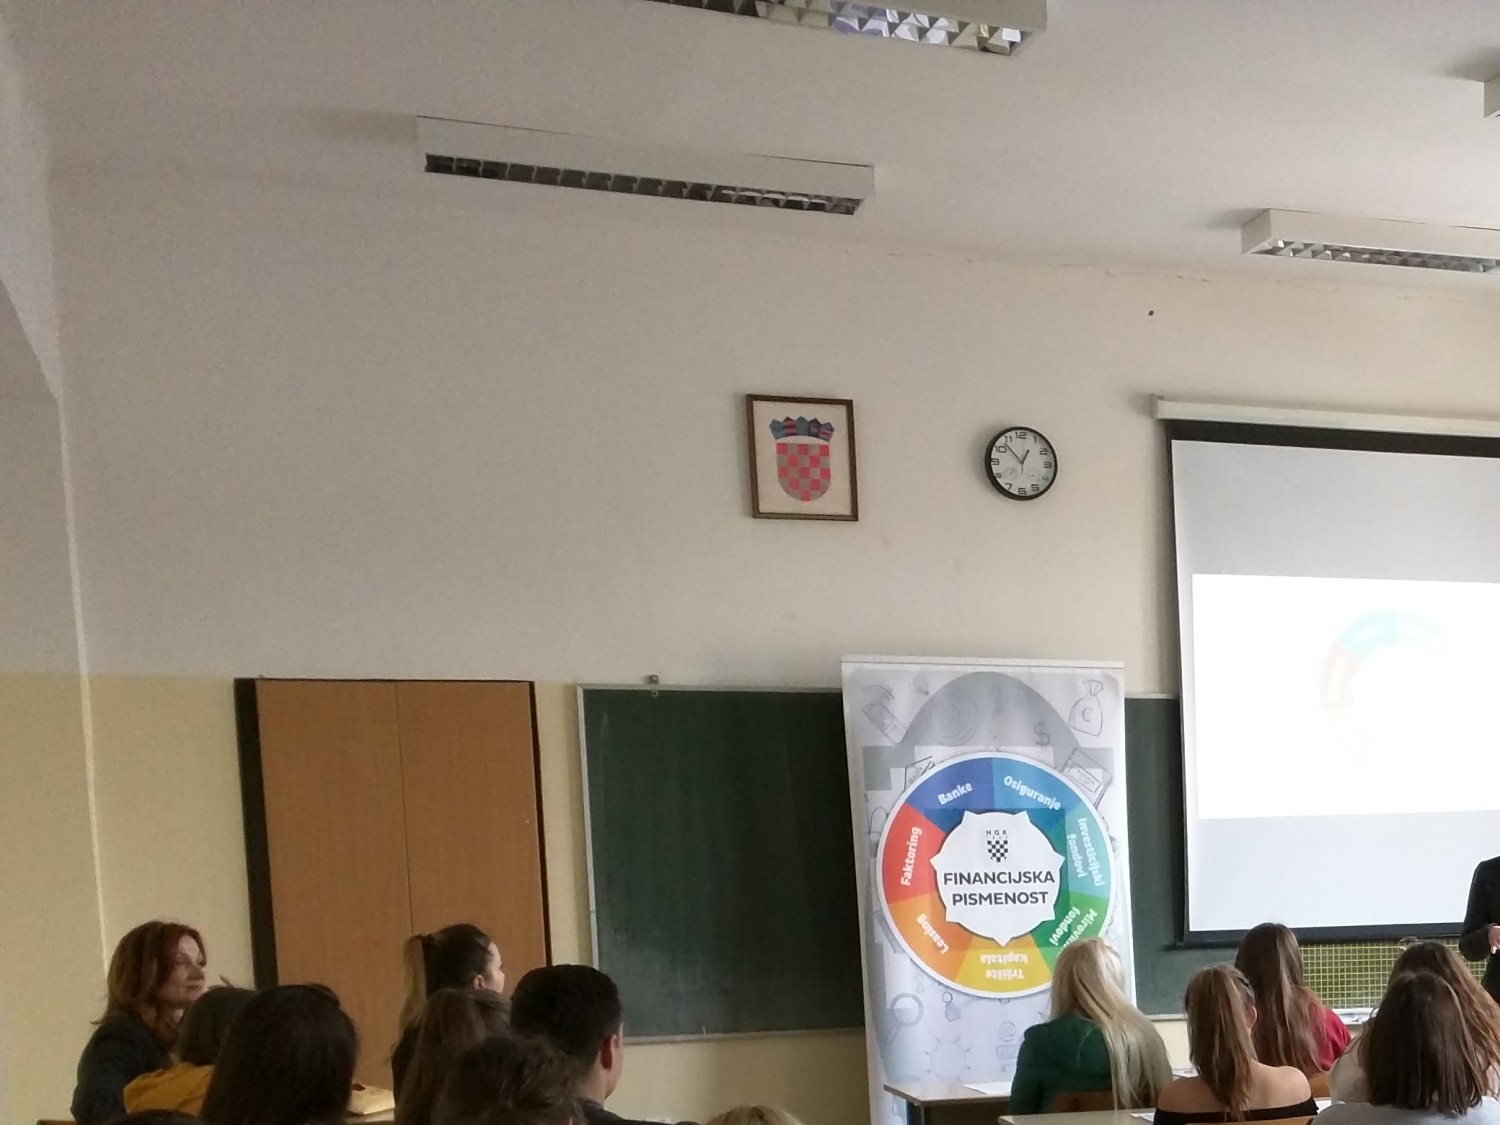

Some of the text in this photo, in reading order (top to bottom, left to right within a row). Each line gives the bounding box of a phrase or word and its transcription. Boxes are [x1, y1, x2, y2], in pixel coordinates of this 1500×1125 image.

[1004, 435, 1013, 443] 11
[994, 445, 1006, 453] 10
[1039, 447, 1048, 455] 2
[1004, 482, 1013, 490] 7
[1018, 487, 1027, 495] 6
[1030, 483, 1039, 492] 5
[937, 782, 973, 805] Banke
[1003, 775, 1062, 811] Osiguranje
[901, 827, 922, 886] Faktoring
[1067, 833, 1088, 878] fondovi
[1078, 817, 1104, 887] Investicijski
[943, 871, 1055, 885] FINANCIJSKA
[952, 891, 1049, 906] PISMENOST
[916, 913, 949, 954] Leasing
[1049, 906, 1081, 946] fondovi
